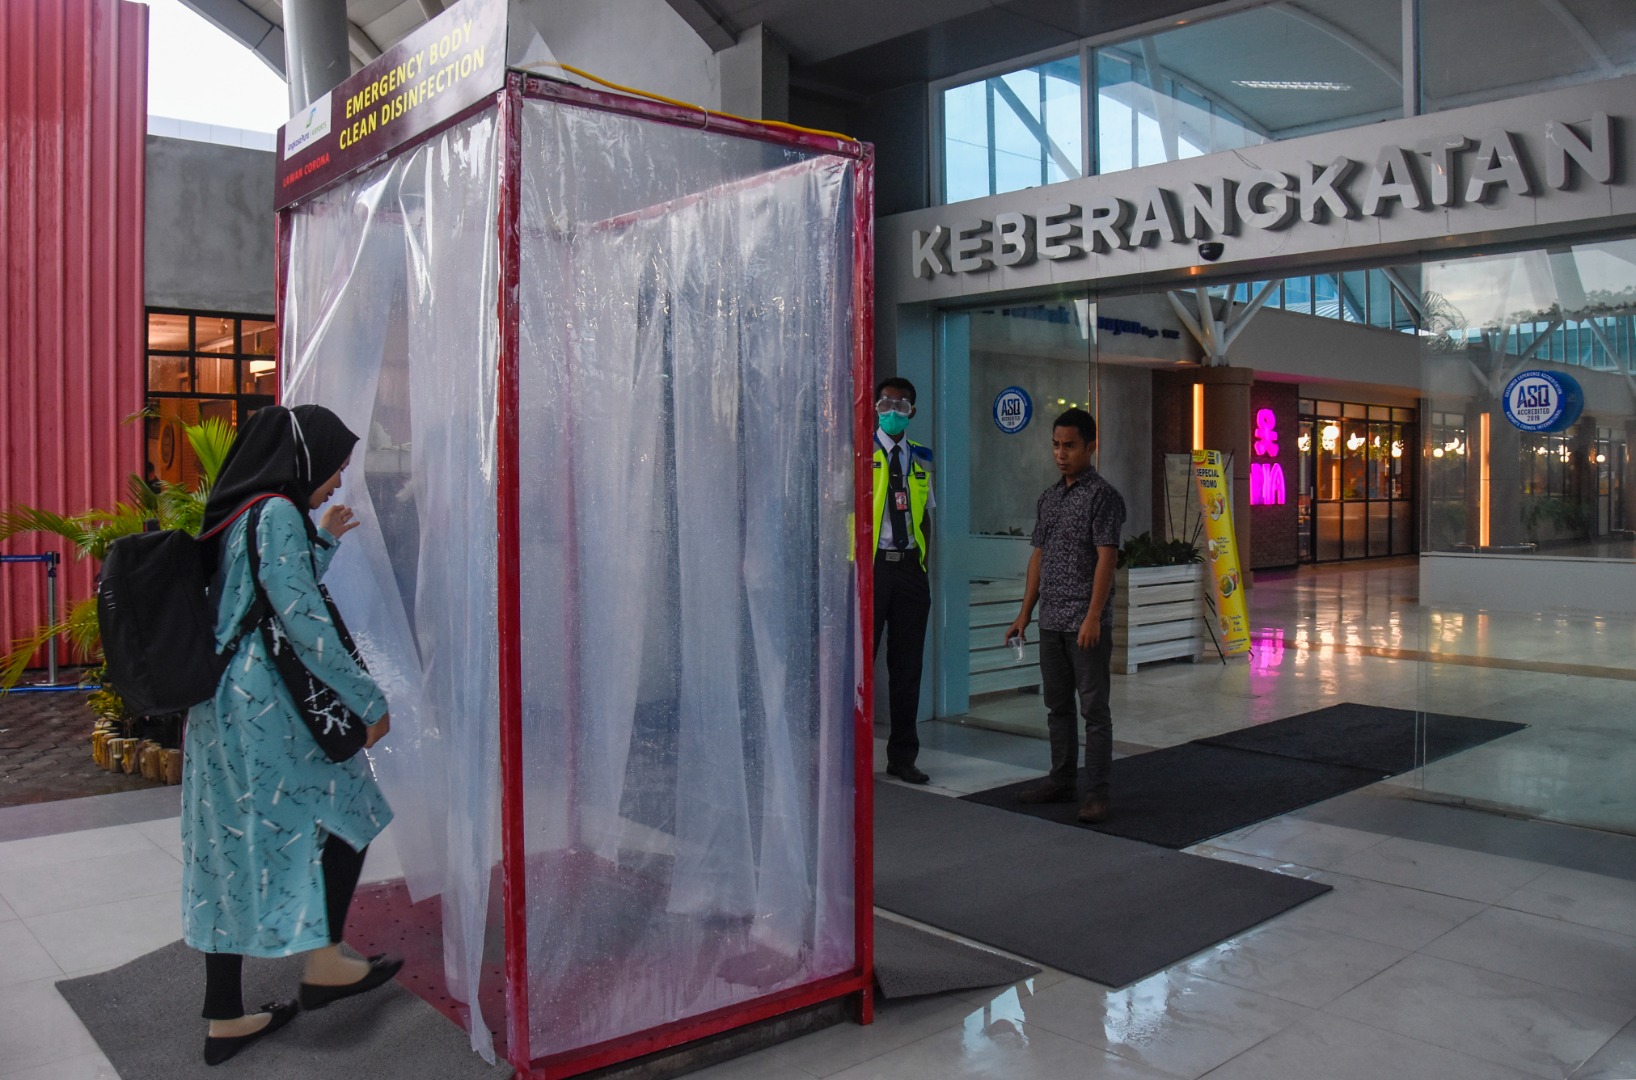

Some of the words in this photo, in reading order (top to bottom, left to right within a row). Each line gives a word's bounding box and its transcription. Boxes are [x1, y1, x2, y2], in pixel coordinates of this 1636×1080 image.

[345, 50, 424, 119] EMERGENCY
[429, 19, 473, 66] BODY
[339, 110, 377, 150] CLEAN
[381, 44, 485, 126] DISINFECTION
[283, 168, 303, 188] LAWAN
[304, 152, 330, 175] CORONA
[911, 110, 1615, 279] KEBERANGKATAN
[1516, 384, 1551, 408] ASQ
[1517, 371, 1540, 381] EXPERIENCE
[1540, 372, 1563, 395] ACCREDITATION
[1001, 398, 1021, 416] ASQ
[1536, 409, 1563, 430] INTERNATIONAL
